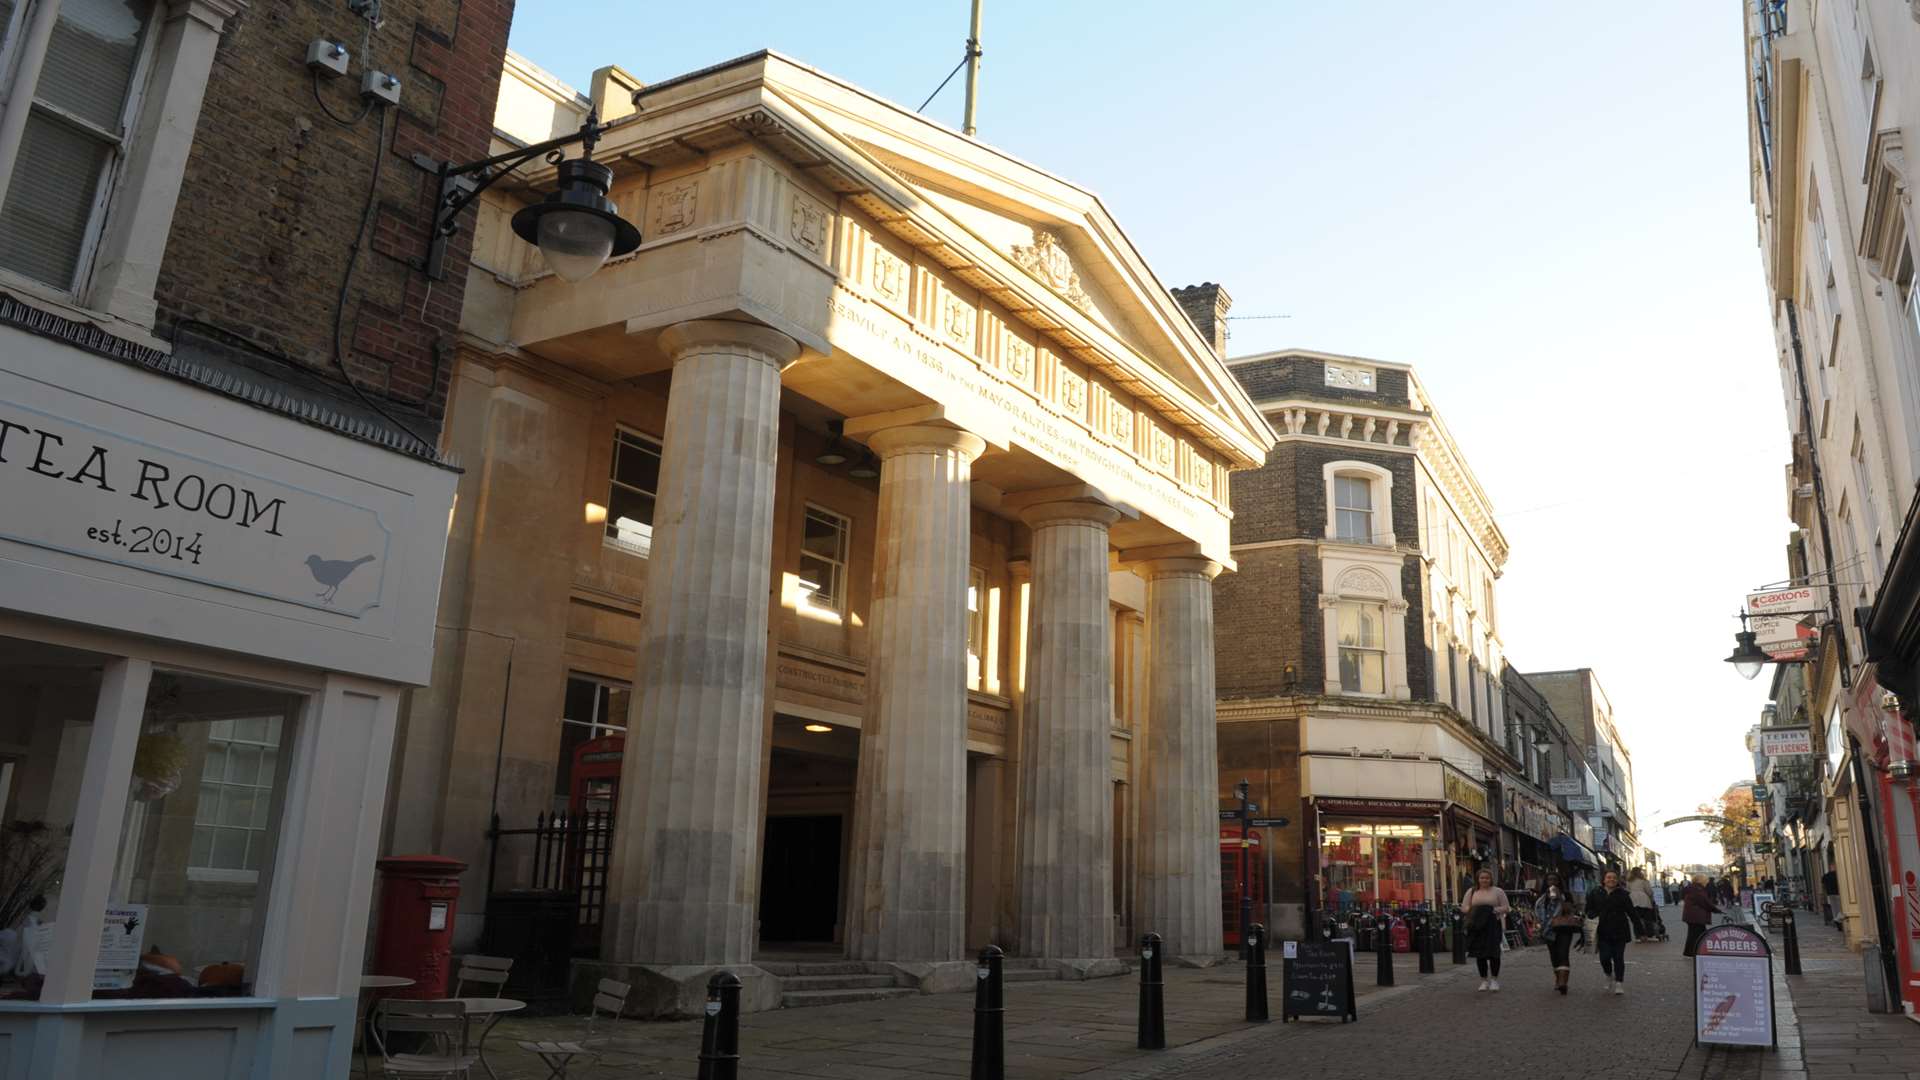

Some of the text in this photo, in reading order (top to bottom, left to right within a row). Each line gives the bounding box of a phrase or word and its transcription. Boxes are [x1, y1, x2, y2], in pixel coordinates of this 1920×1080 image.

[0, 419, 286, 537] TEA ROOM
[1761, 590, 1810, 603] caxtons
[1707, 941, 1758, 951] BARBERS
